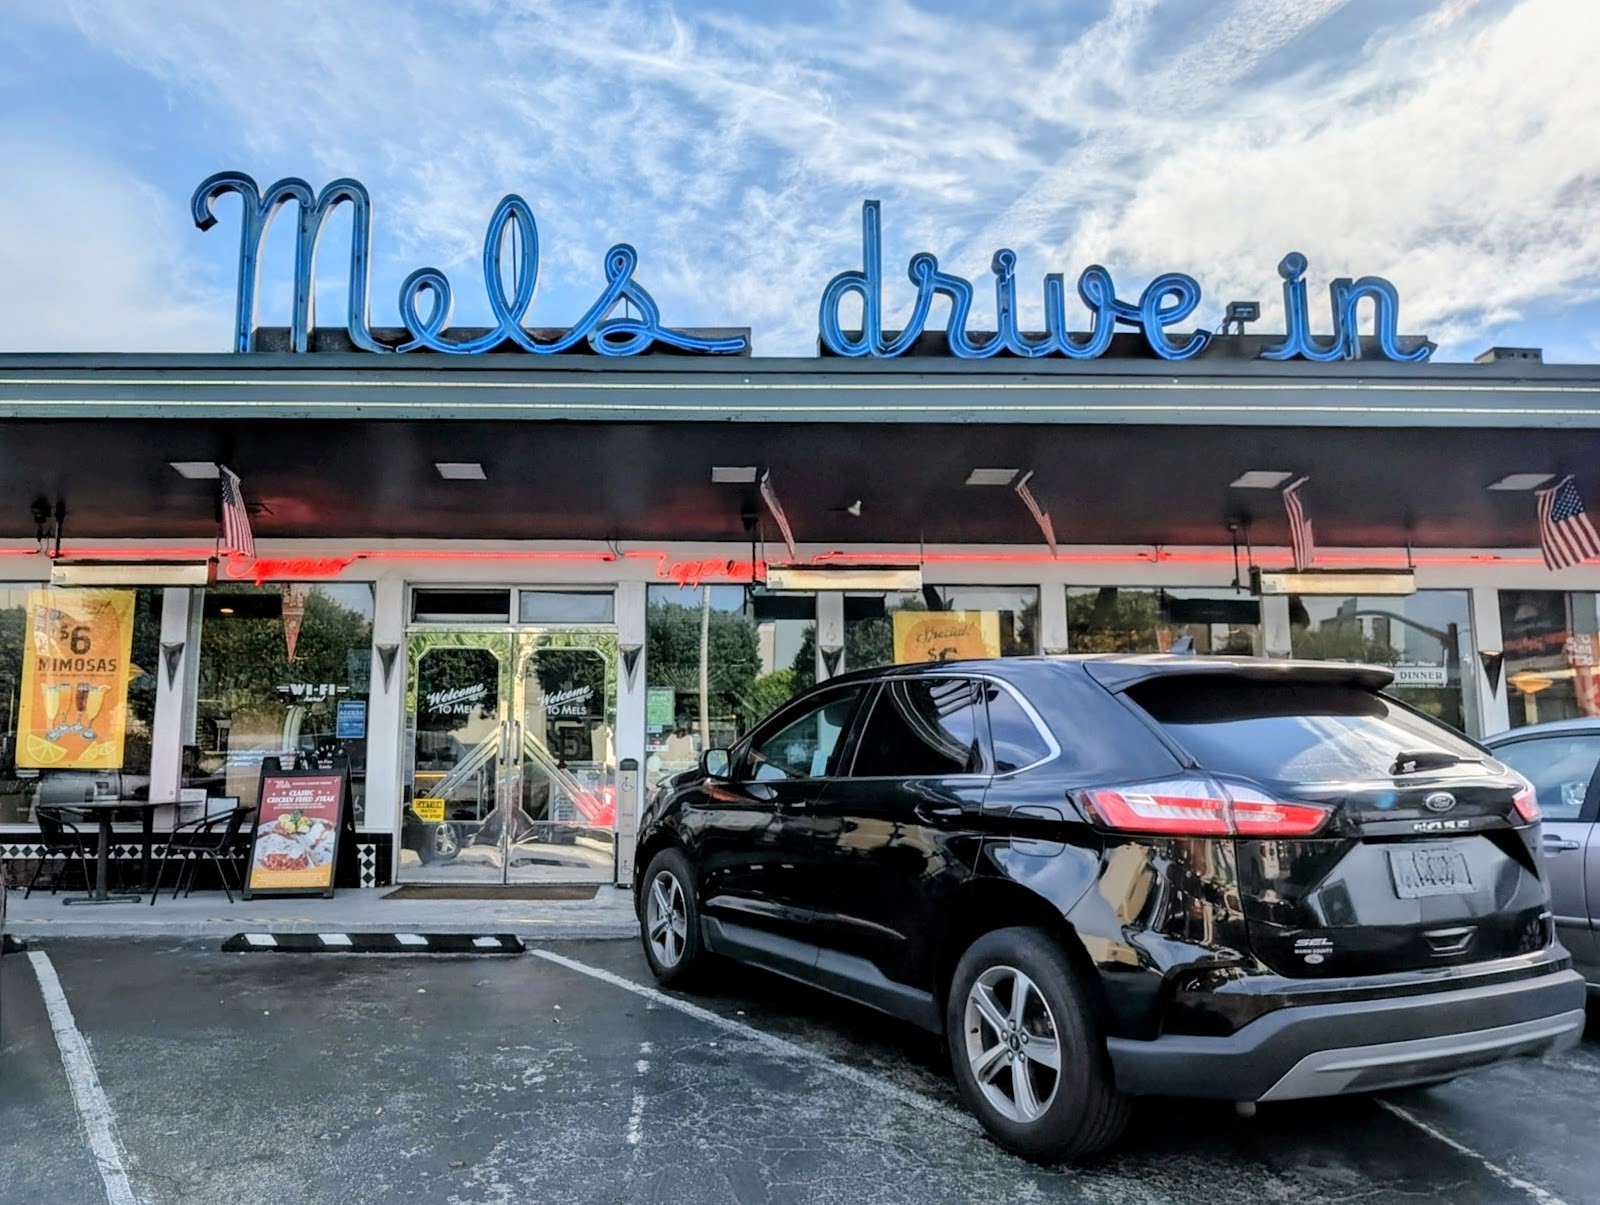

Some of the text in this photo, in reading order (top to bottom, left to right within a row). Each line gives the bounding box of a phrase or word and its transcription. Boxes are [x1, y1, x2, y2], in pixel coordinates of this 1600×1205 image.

[191, 170, 1437, 361] Mels drive in
[60, 625, 91, 655] $6
[38, 658, 117, 672] MIMOSAS
[1400, 671, 1443, 680] DINNER
[290, 684, 336, 696] WI-FI
[427, 683, 487, 706] Welcome
[537, 685, 593, 707] Welcome
[438, 704, 451, 714] TO
[547, 705, 560, 715] TO
[1294, 938, 1334, 947] SEL
